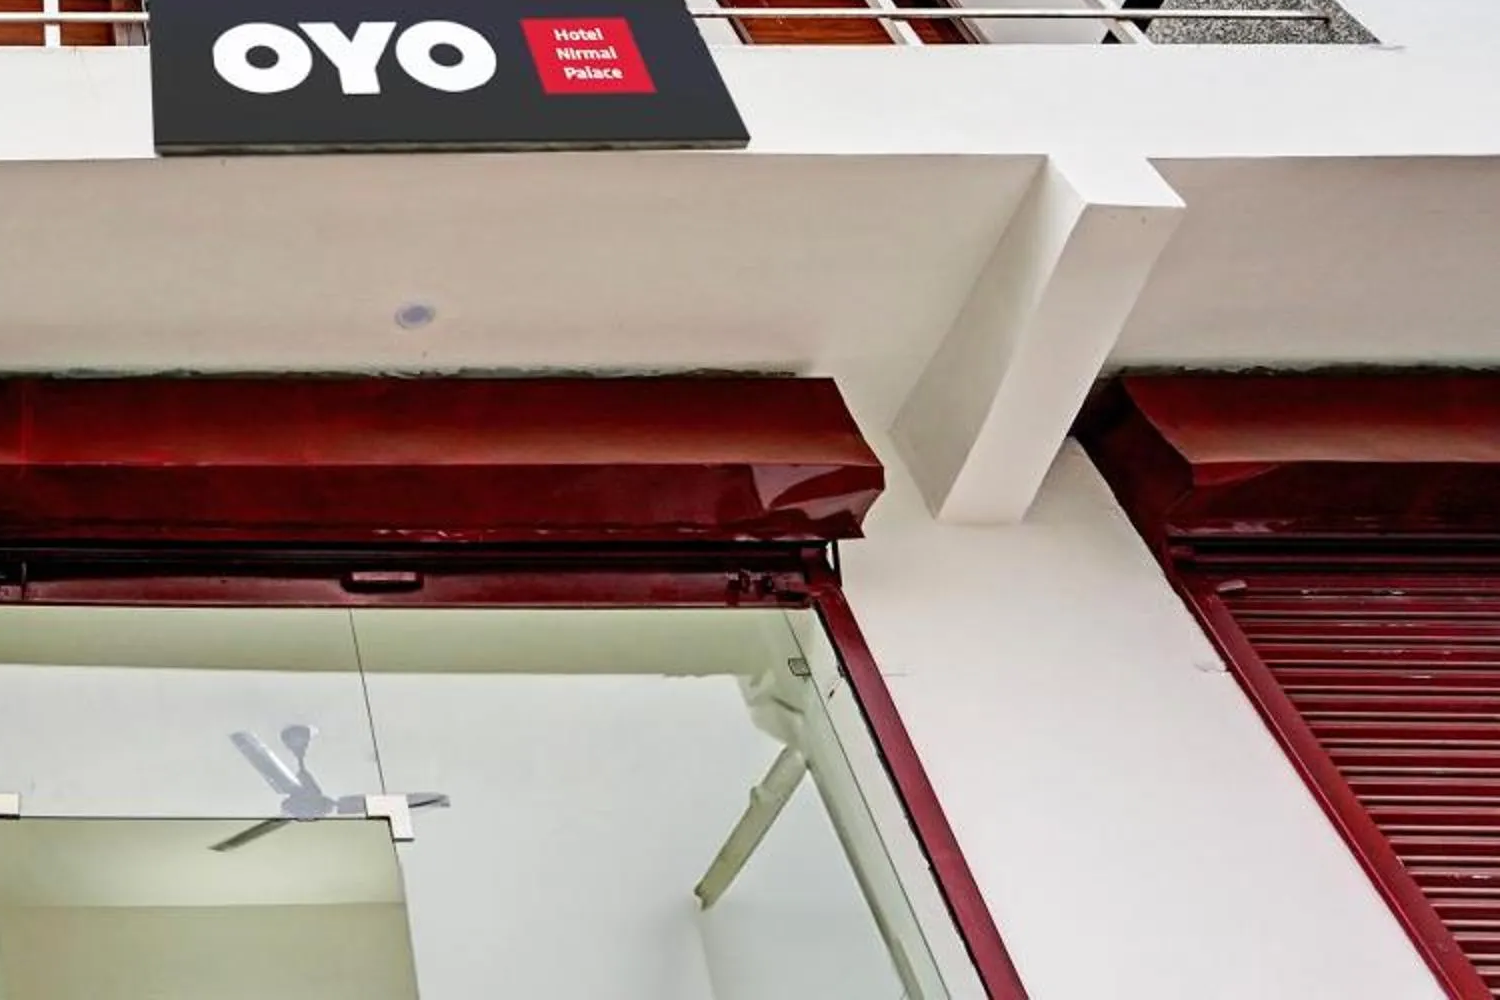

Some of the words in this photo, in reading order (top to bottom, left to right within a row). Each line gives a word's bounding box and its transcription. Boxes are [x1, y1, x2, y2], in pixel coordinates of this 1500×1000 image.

[553, 27, 604, 41] Hotel
[212, 19, 497, 95] OYO
[555, 45, 618, 60] Nirmal
[563, 65, 623, 80] Palace
